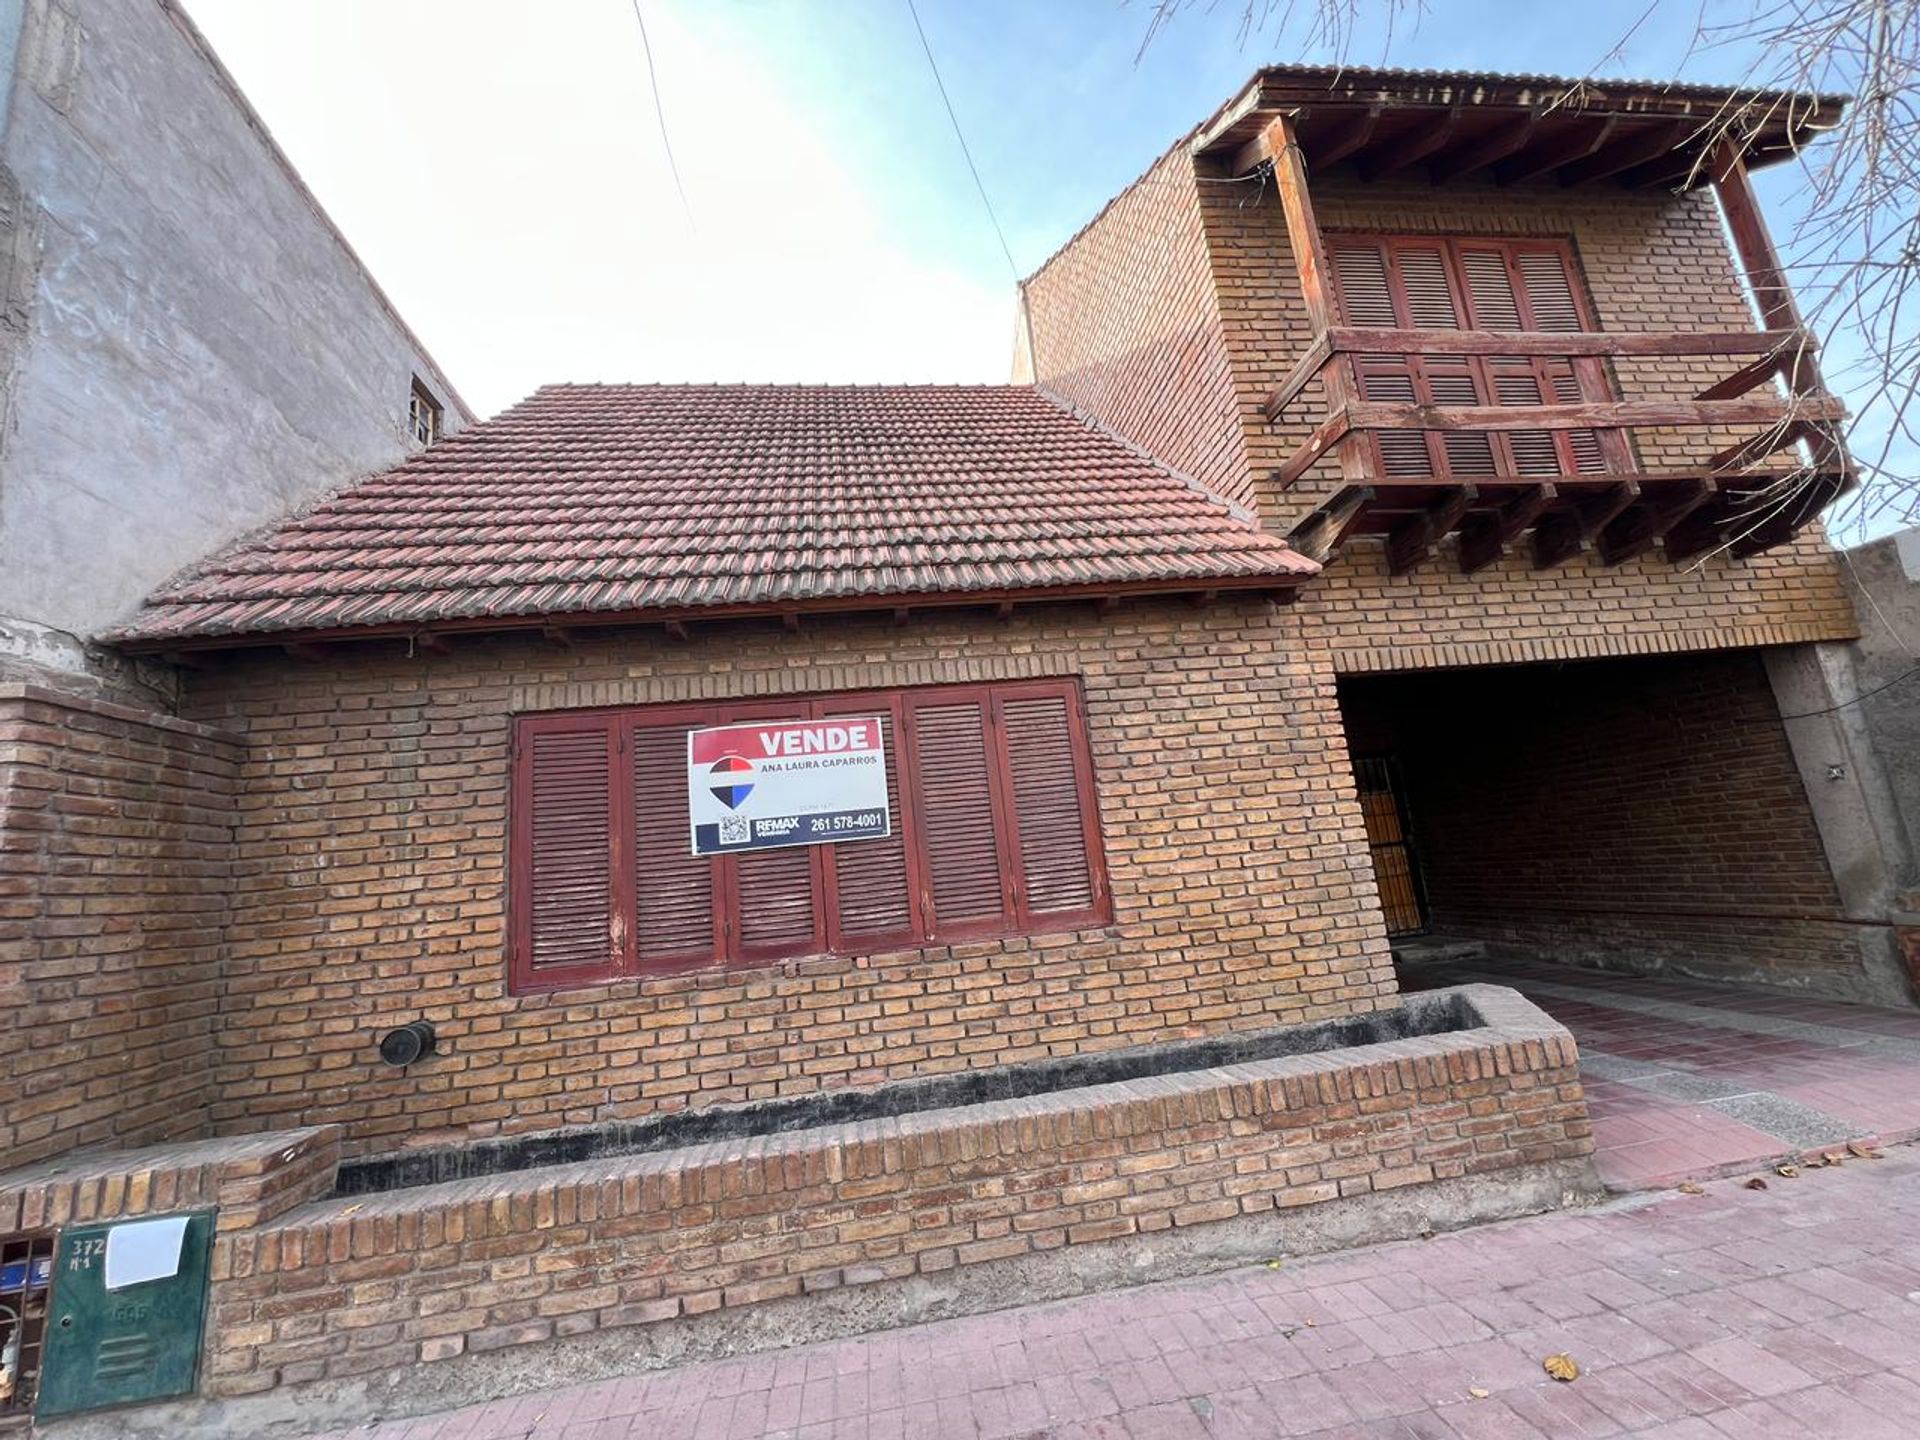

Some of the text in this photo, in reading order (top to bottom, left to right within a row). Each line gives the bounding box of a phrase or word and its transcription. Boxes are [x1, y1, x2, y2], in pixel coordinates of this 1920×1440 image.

[759, 725, 869, 756] VENDE
[761, 756, 878, 773] ANA LAURA CAPARROS
[811, 813, 883, 832] 261 578-4001
[72, 1239, 105, 1256] 372
